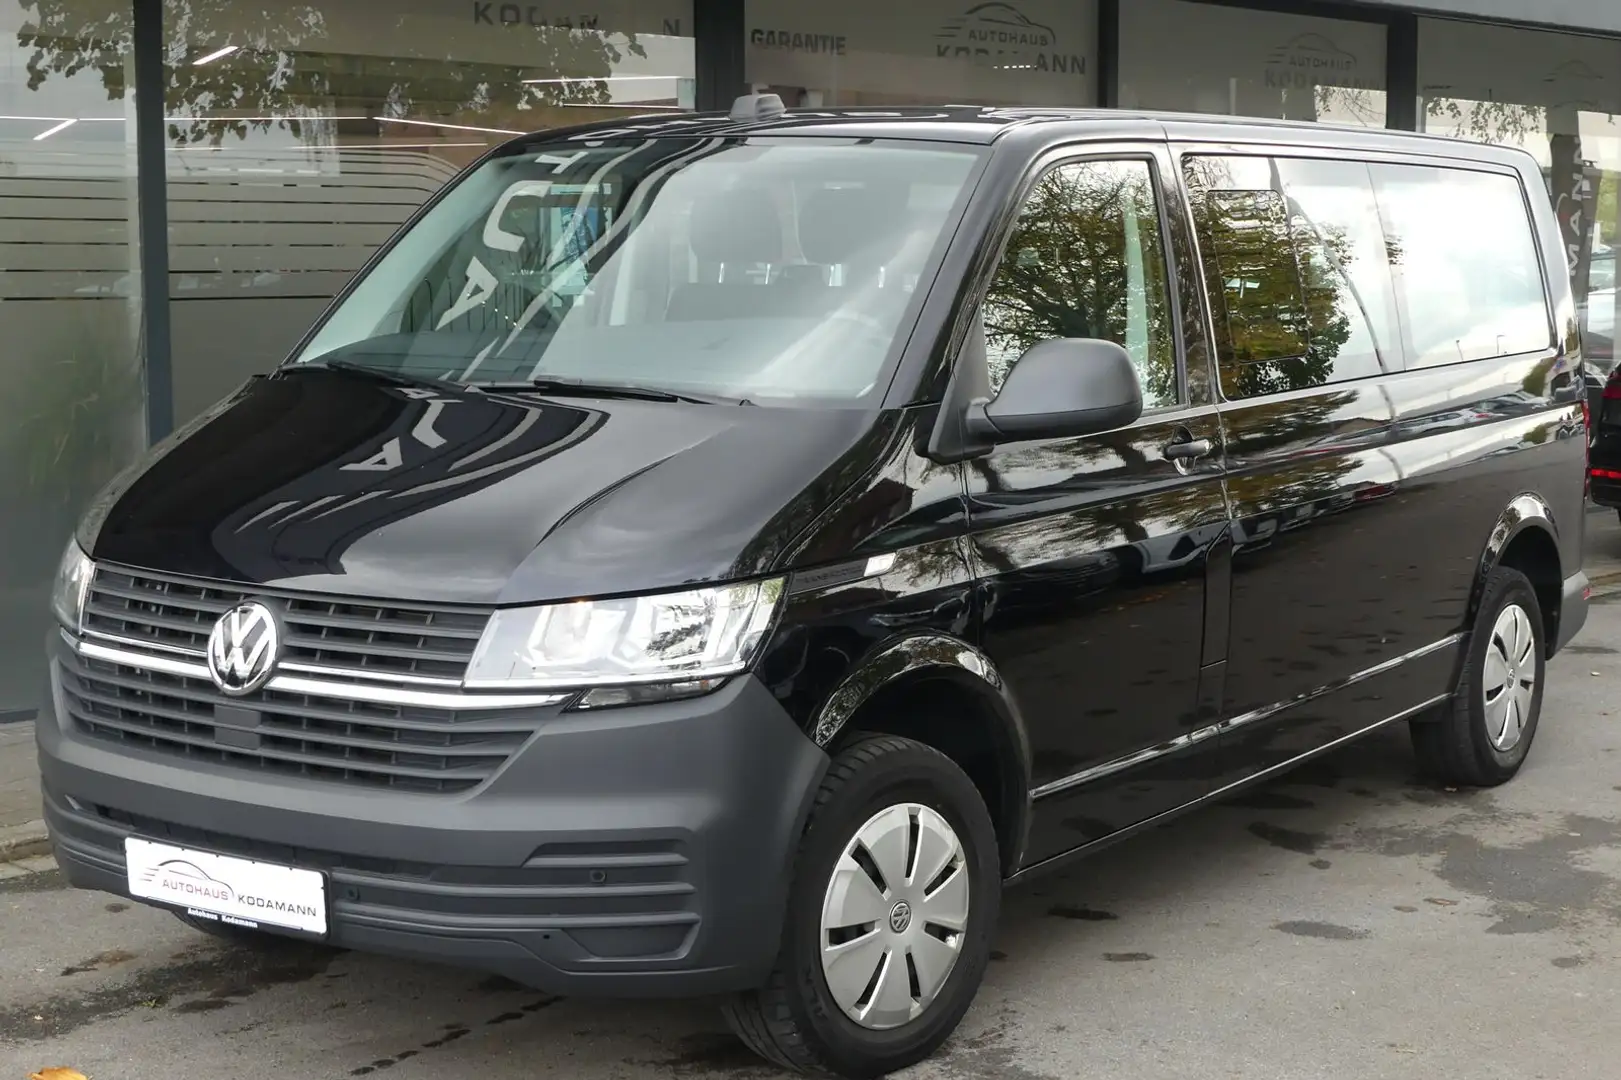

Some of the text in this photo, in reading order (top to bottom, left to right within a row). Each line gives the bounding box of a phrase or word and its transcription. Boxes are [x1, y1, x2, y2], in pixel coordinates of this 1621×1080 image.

[750, 28, 847, 56] GARANTIE
[968, 29, 1049, 47] AUTOHAUS
[162, 879, 317, 917] AUTOHAUS KODAMANN
[187, 907, 258, 929] Autohaus Kodamann
